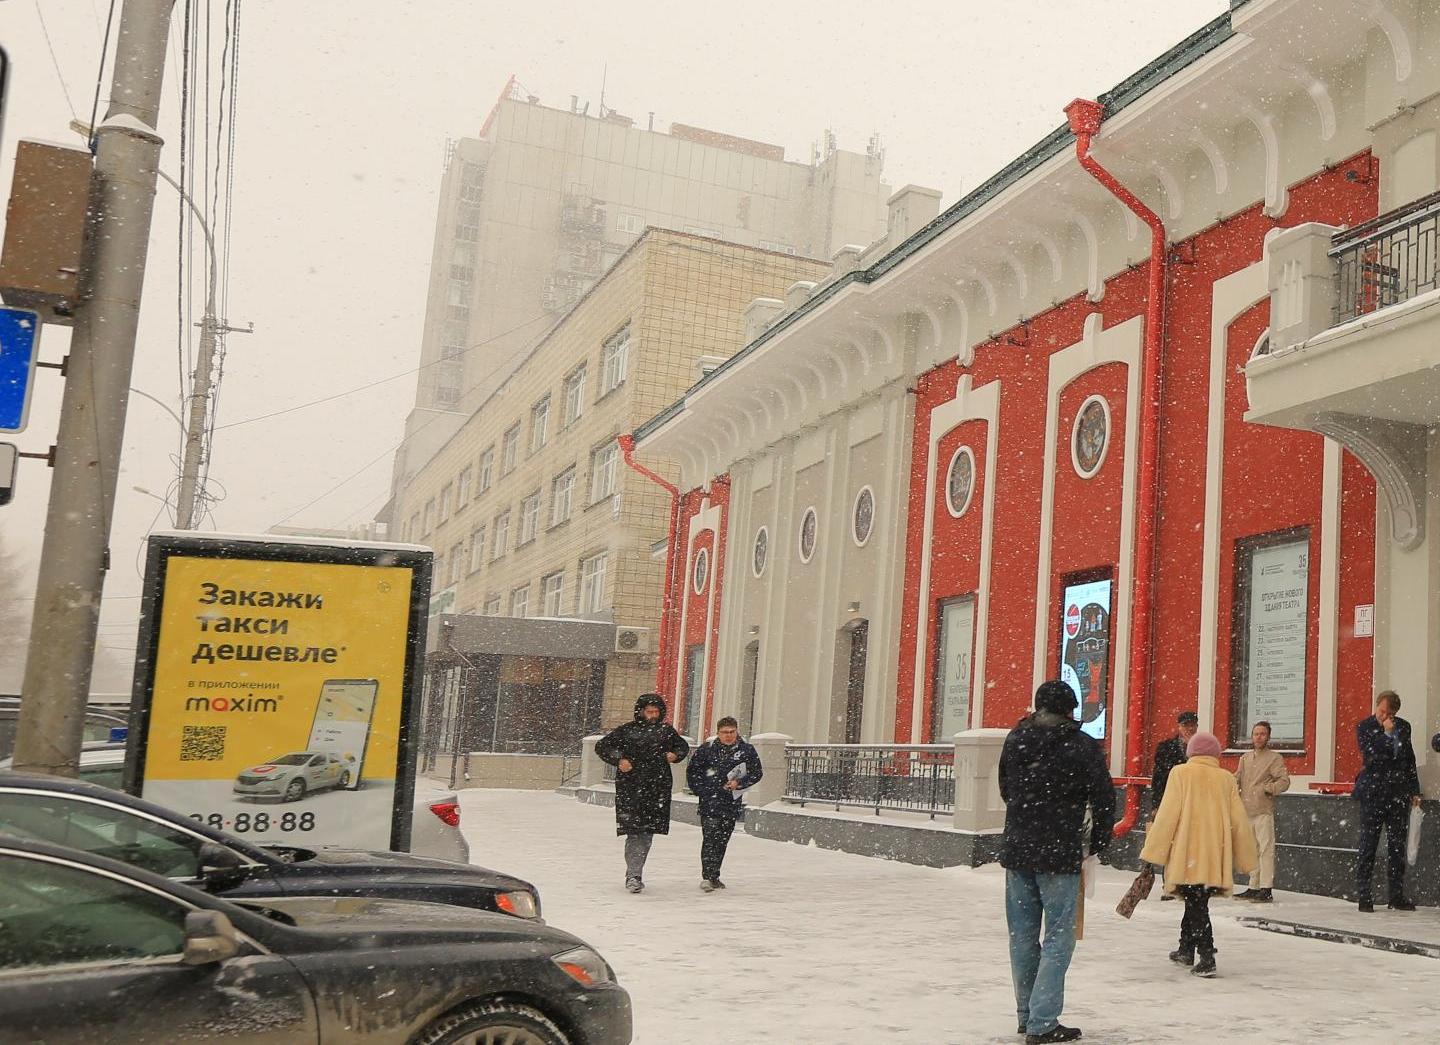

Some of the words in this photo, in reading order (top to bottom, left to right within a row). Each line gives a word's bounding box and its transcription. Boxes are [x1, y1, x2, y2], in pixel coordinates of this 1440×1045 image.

[198, 582, 323, 609] Закажи
[196, 615, 289, 635] такси
[188, 680, 195, 688] в
[199, 680, 280, 690] приложении
